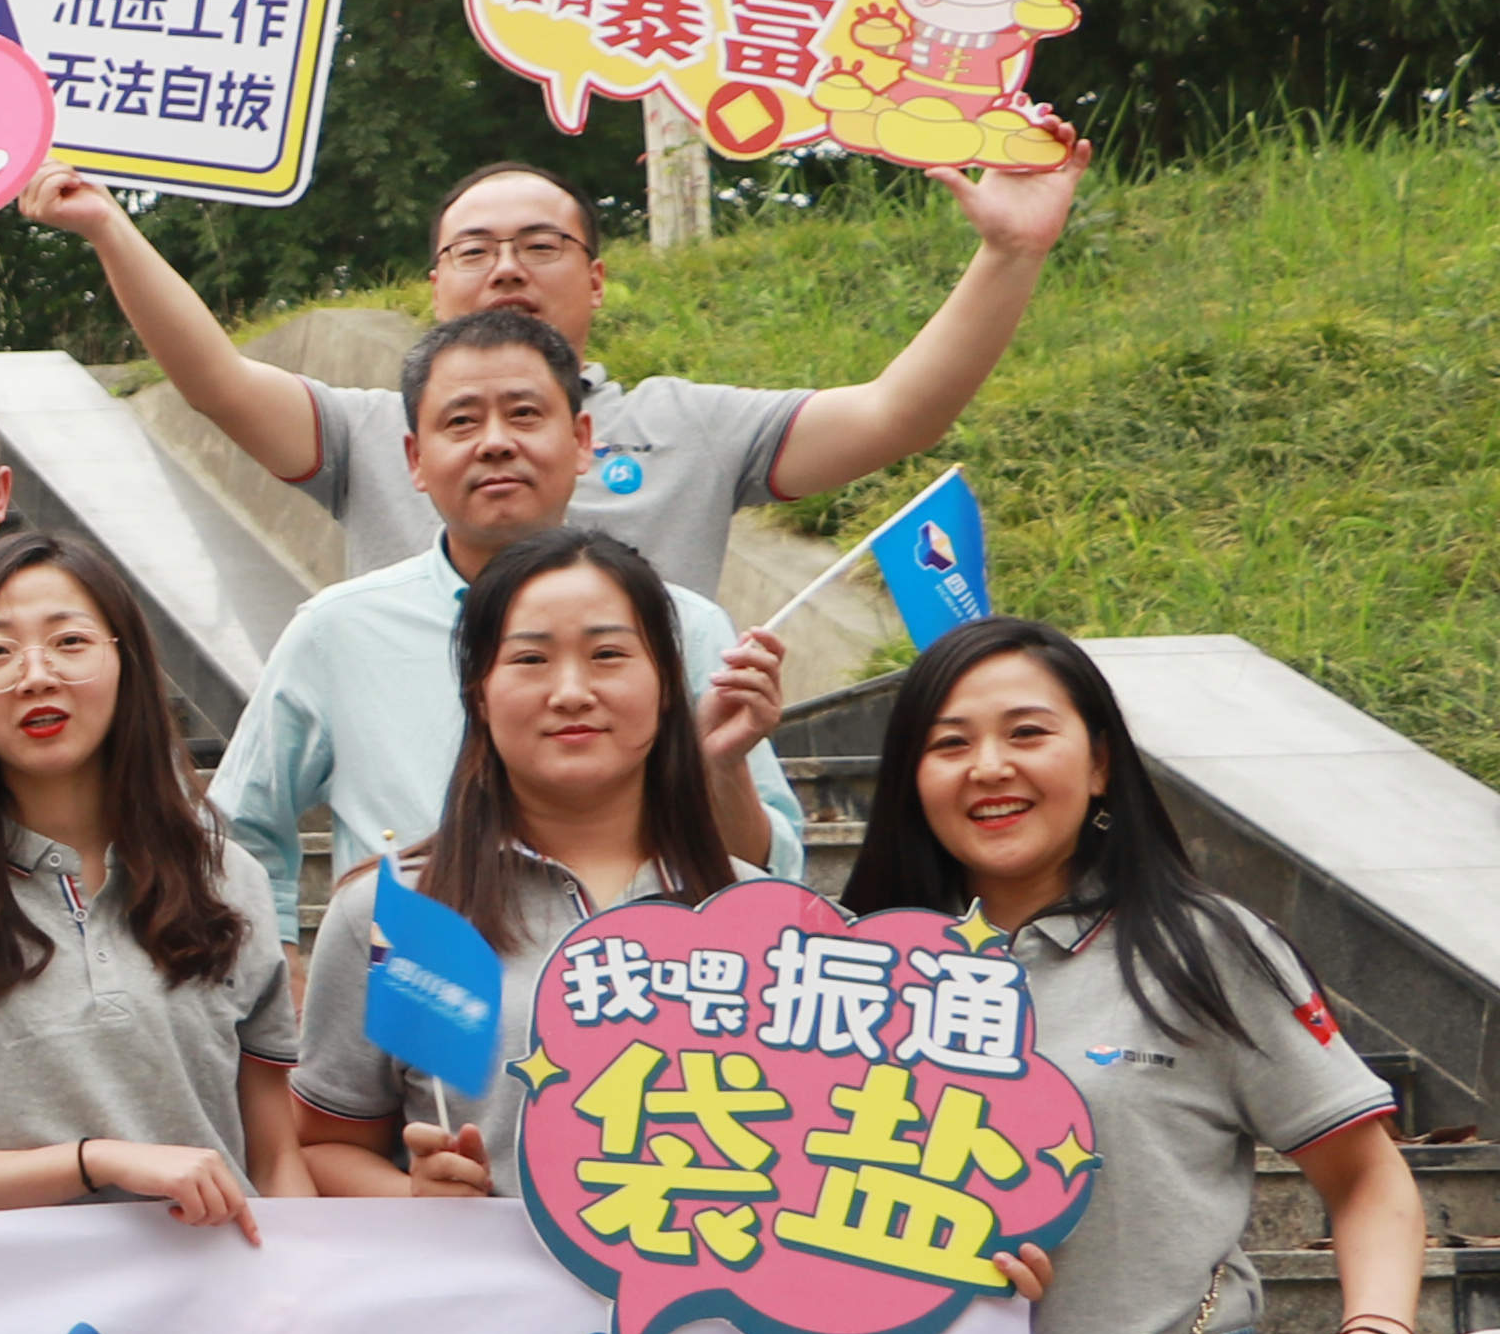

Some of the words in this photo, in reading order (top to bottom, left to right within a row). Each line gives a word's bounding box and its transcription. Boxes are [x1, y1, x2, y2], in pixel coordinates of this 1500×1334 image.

[44, 50, 276, 133] 无法自拔
[561, 929, 1024, 1077] 我喂振通
[572, 1040, 1024, 1289] 袋盐
